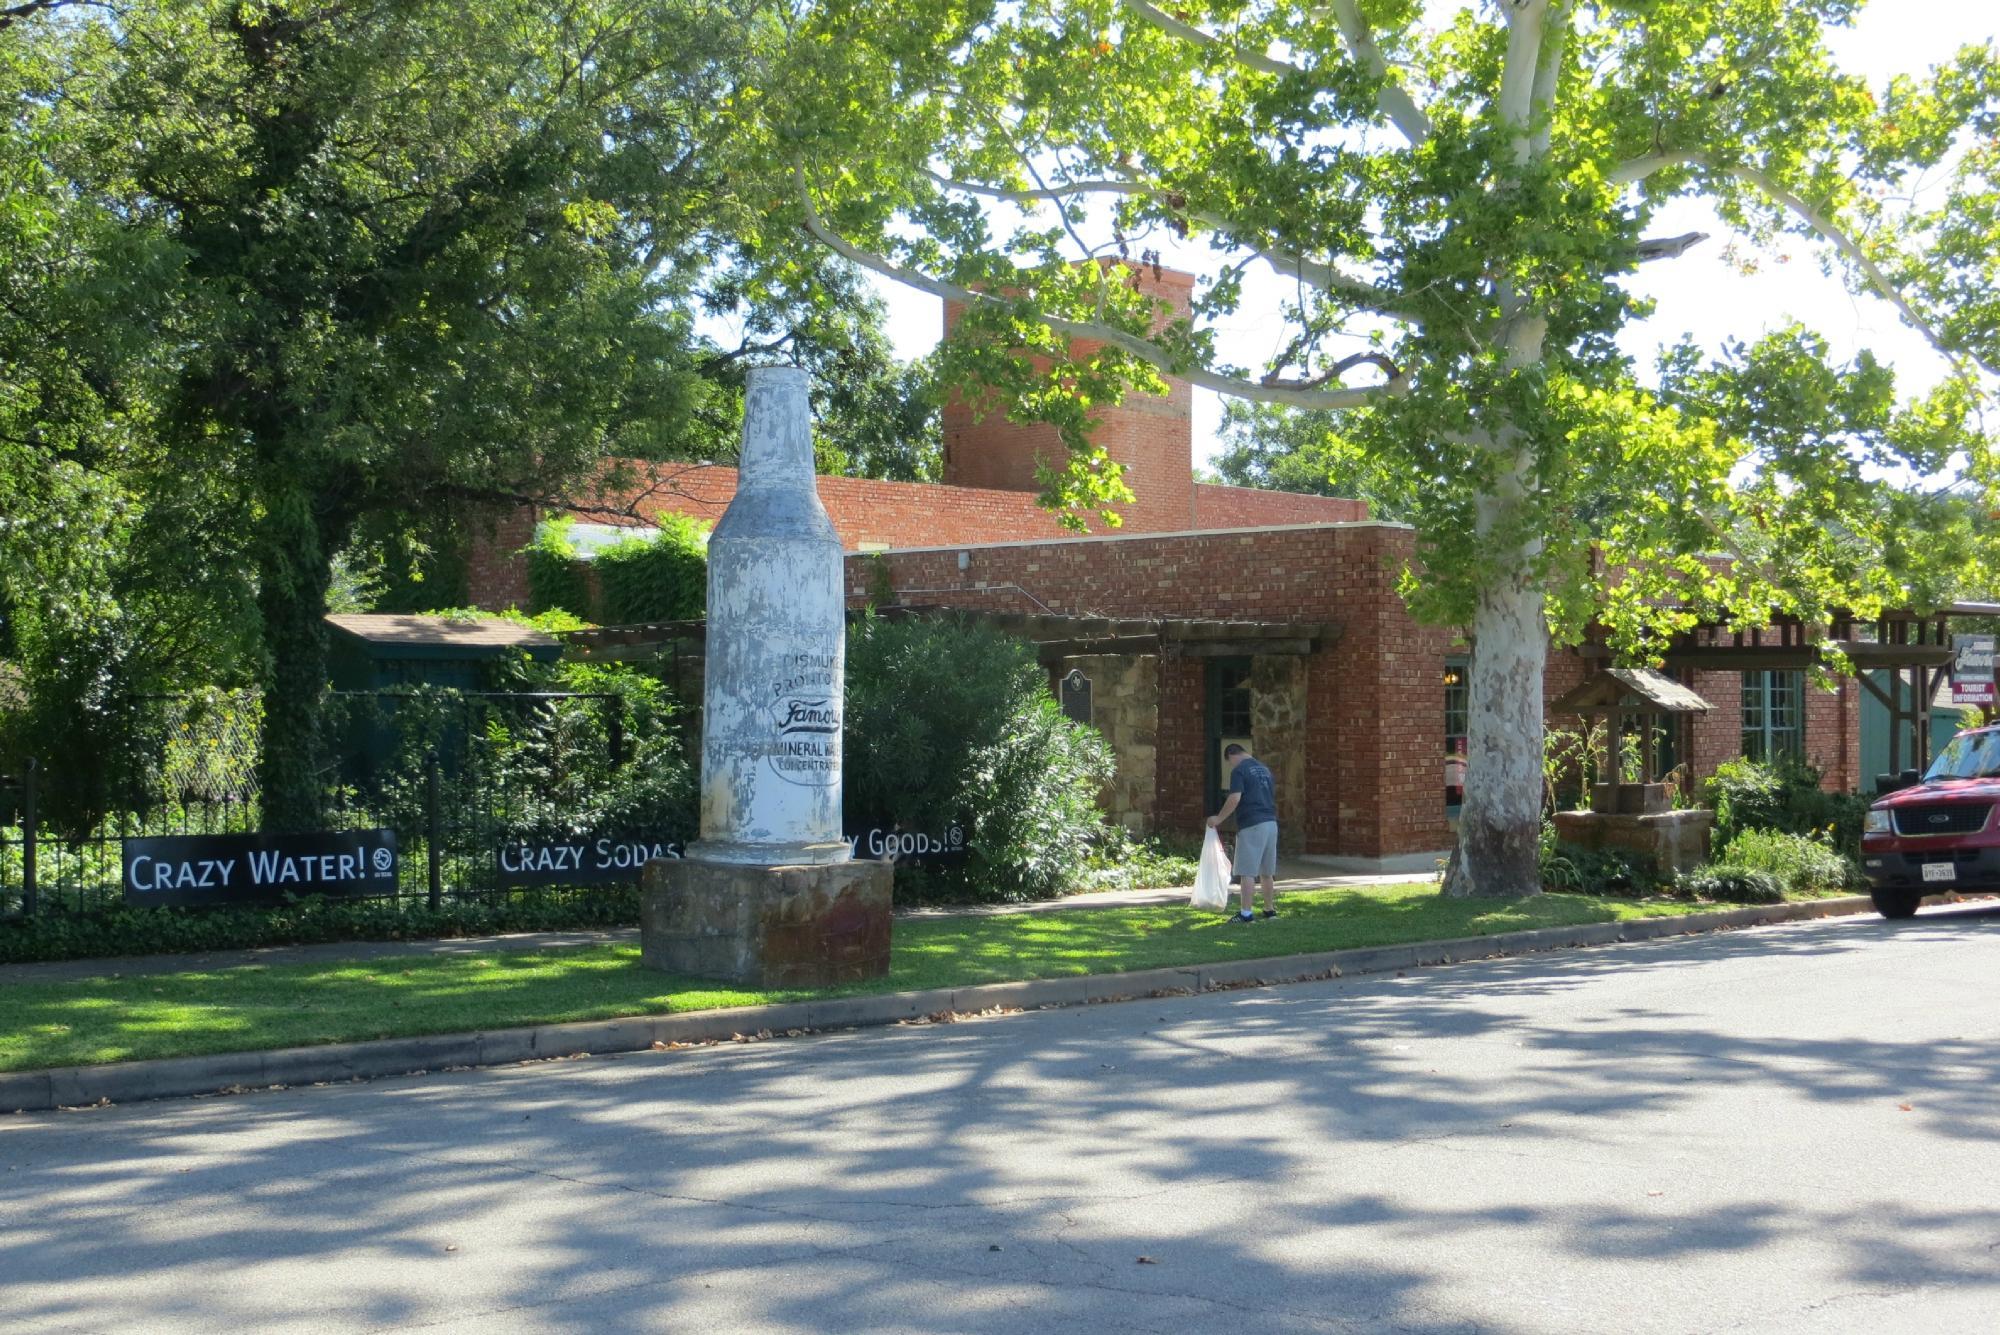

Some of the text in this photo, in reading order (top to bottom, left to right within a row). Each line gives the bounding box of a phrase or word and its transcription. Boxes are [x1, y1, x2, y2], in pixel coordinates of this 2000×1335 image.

[1961, 683, 1986, 692] TOURIST
[1953, 694, 1993, 702] INFORMATION
[774, 741, 823, 757] MINERAL
[501, 841, 584, 872] CRAZY
[130, 846, 366, 890] CRAZY WATER!
